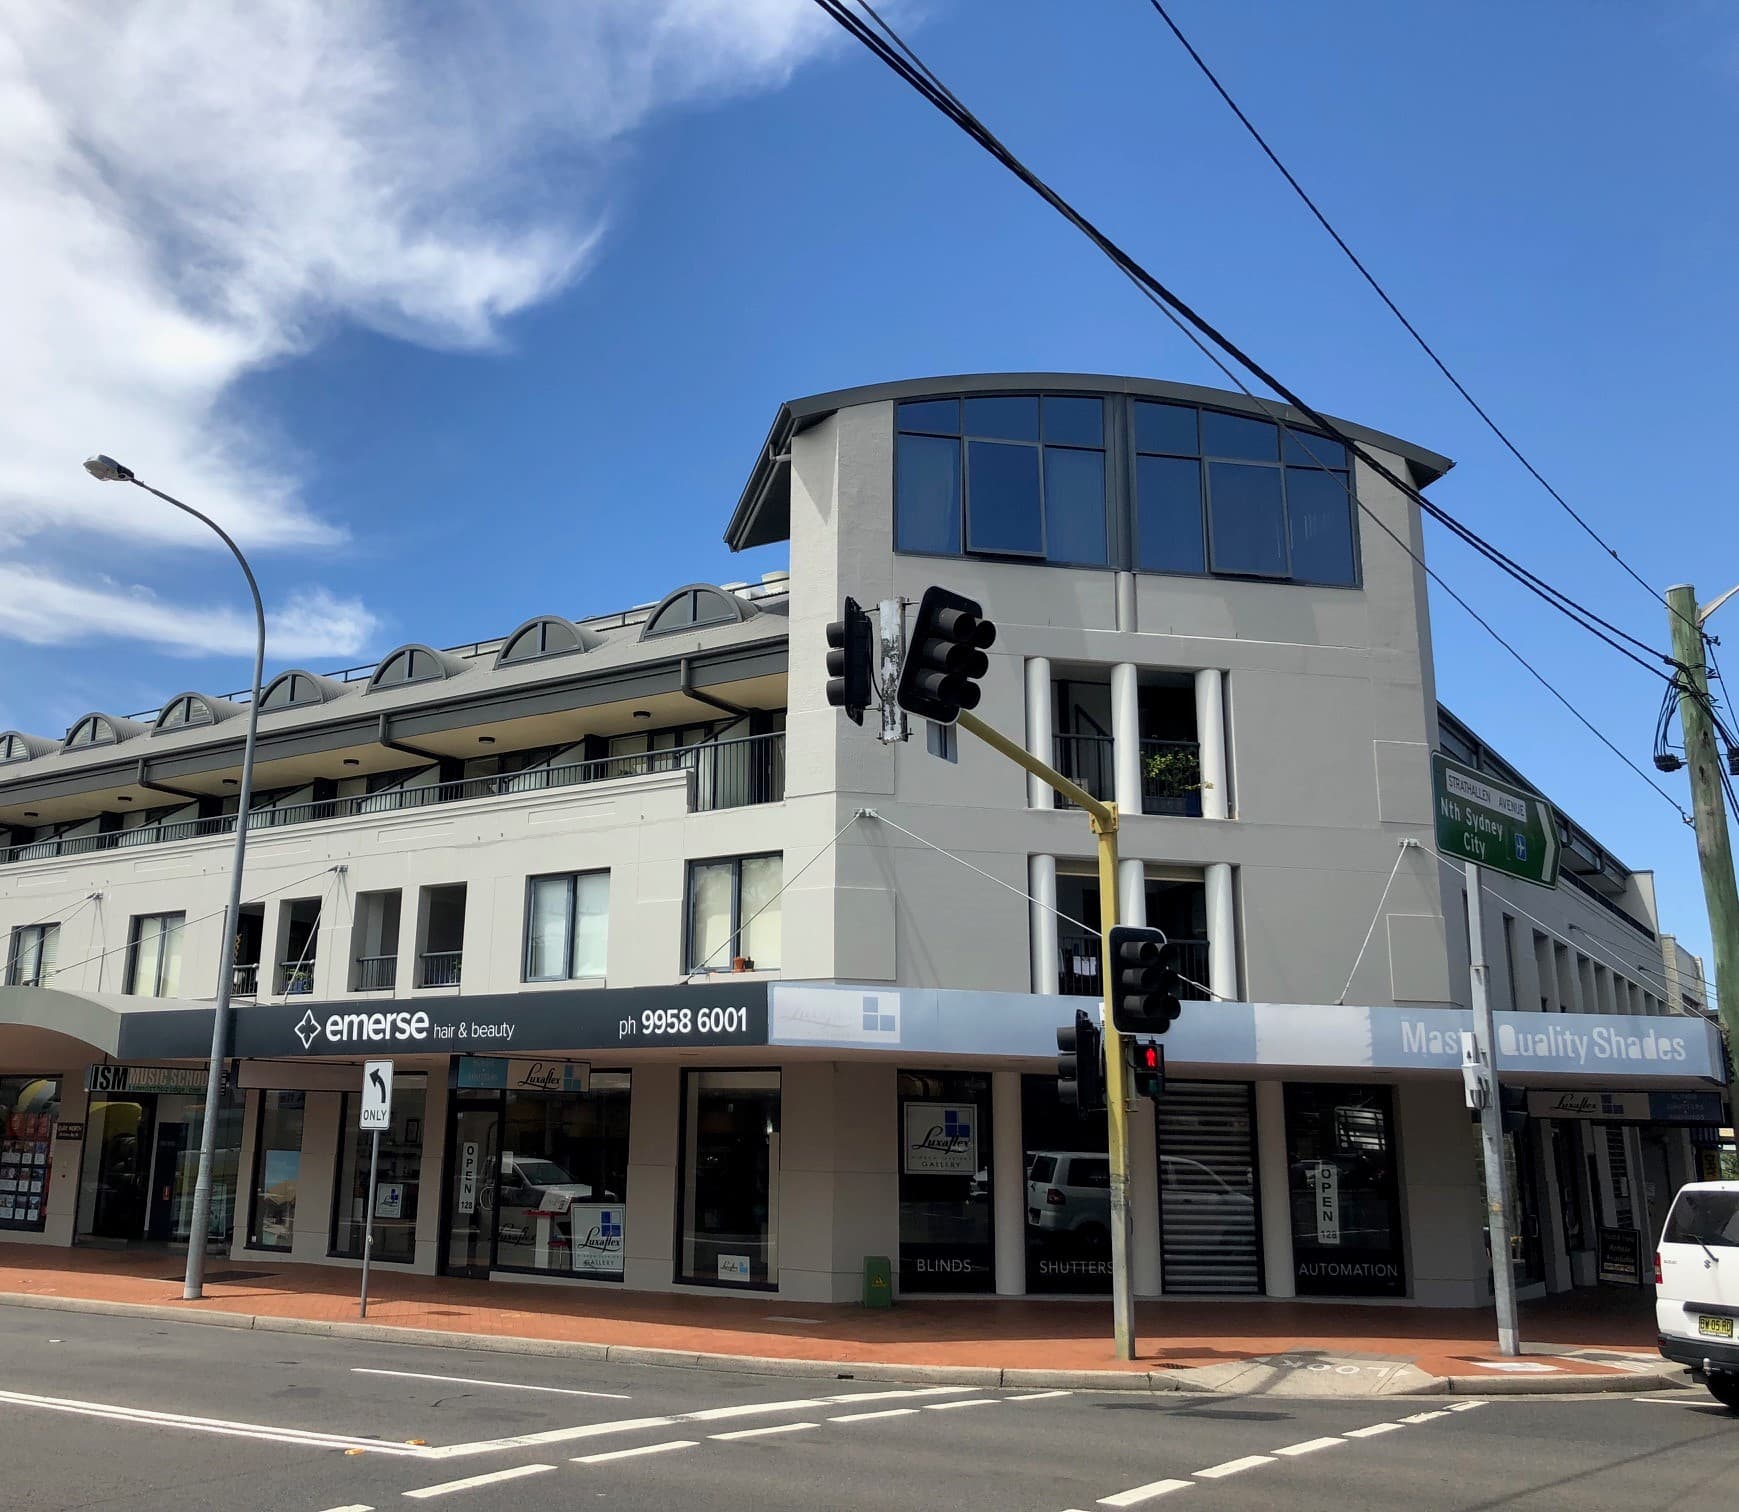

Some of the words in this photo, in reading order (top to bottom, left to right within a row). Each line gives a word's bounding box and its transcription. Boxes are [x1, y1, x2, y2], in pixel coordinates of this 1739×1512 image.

[1448, 774, 1491, 804] STRATHALLEN
[1498, 797, 1526, 818] AVENUE
[1440, 797, 1461, 821] Nth
[1465, 807, 1503, 842] Sydney
[1463, 832, 1487, 860] City
[325, 1011, 430, 1041] emerse
[433, 1023, 456, 1039] hair
[458, 1022, 468, 1038] &
[471, 1021, 515, 1041] beauty
[619, 1016, 637, 1040] ph
[641, 1008, 692, 1035] 9958
[697, 1006, 748, 1033] 6001
[1497, 1023, 1589, 1065] Quality
[1593, 1026, 1687, 1061] Shades
[92, 1066, 129, 1091] ISM
[128, 1068, 169, 1086] MUSIC
[170, 1069, 209, 1087] SCHOO
[517, 1062, 560, 1091] Luxaflex
[363, 1109, 387, 1121] ONLY
[912, 1125, 971, 1155] Luxaflex
[464, 1145, 475, 1194] OPEN
[460, 1200, 473, 1210] 128
[1320, 1168, 1333, 1222] OPEN
[577, 1225, 622, 1253] Luxaflex
[916, 1258, 972, 1273] BLINDS
[1039, 1260, 1114, 1274] SHUTTERS
[1298, 1263, 1398, 1277] AUTOMATION
